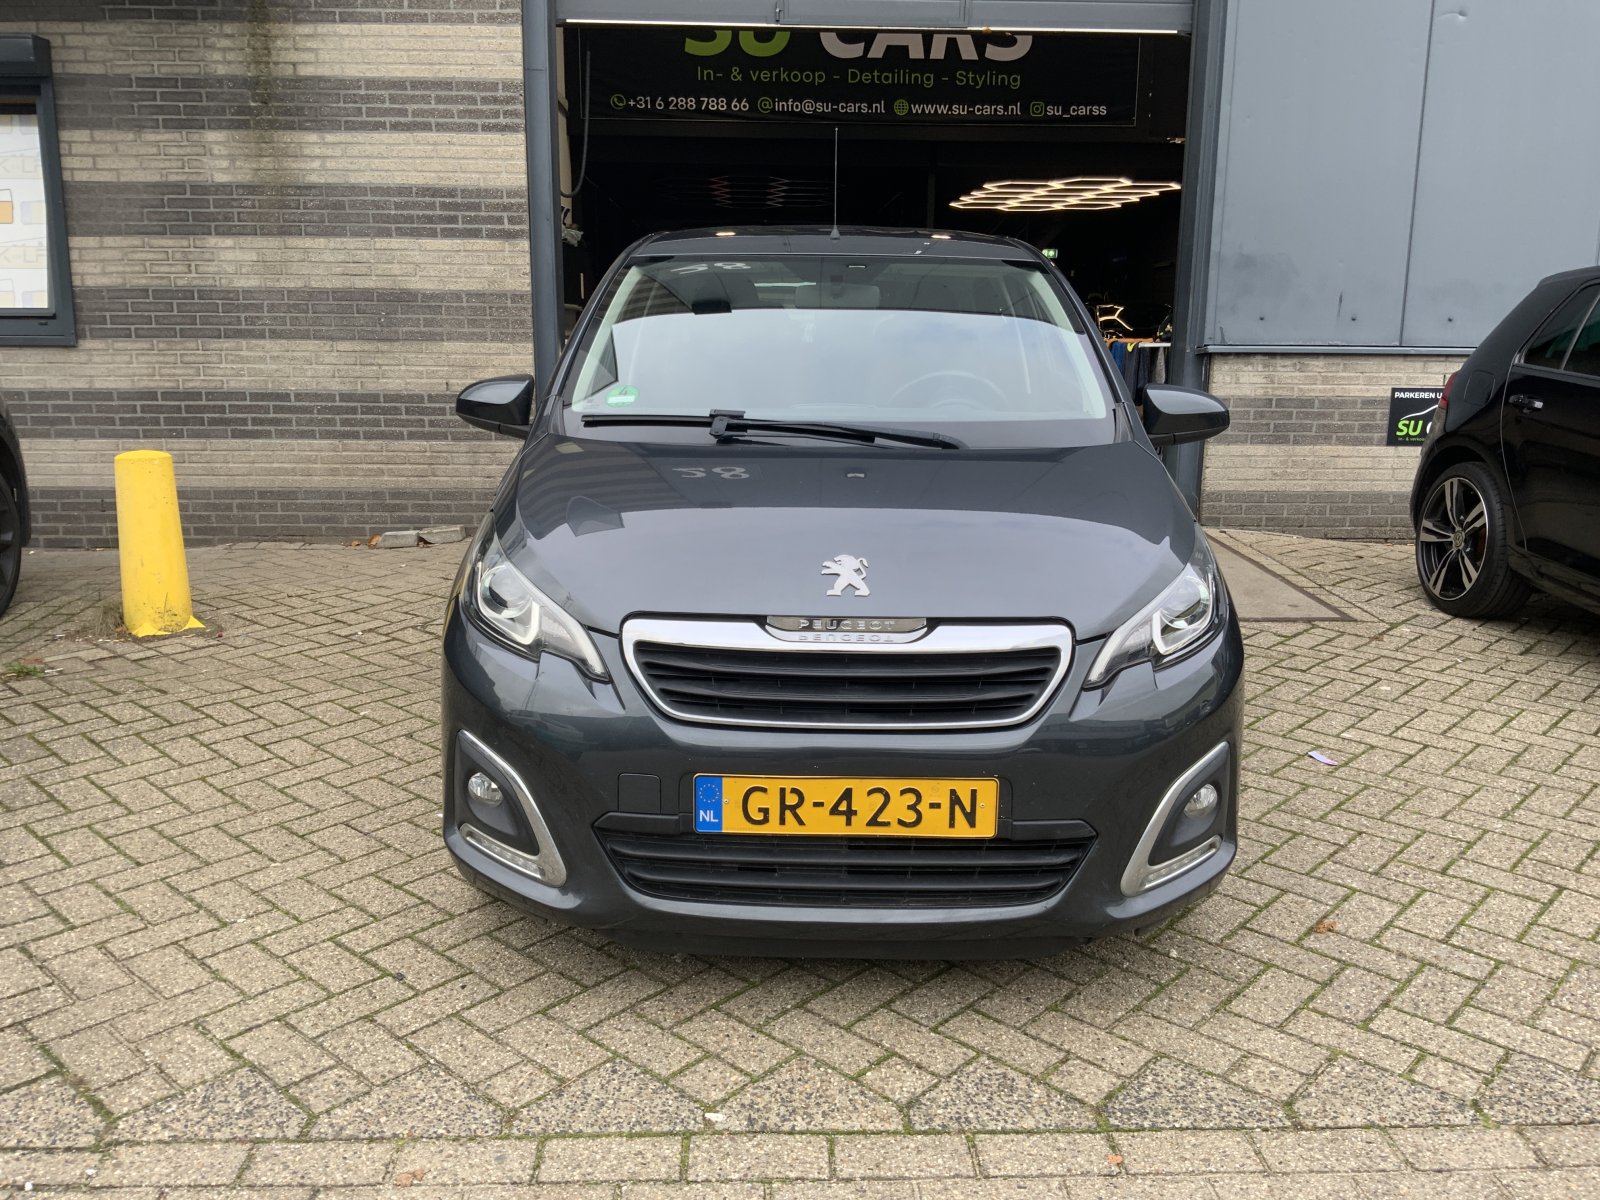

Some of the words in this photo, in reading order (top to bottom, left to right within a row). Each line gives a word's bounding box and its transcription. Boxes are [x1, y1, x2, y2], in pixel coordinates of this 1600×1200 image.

[697, 66, 724, 81] In-
[730, 66, 743, 81] &
[750, 68, 826, 86] verkoop
[848, 69, 934, 88] Detailing
[955, 71, 1021, 90] Styling
[627, 96, 651, 110] +31
[655, 96, 664, 110] 6
[668, 97, 697, 111] 288
[700, 97, 727, 111] 788
[731, 97, 749, 112] 66
[775, 97, 885, 114] info@su-cars.nl
[911, 101, 1021, 116] www.su-cars.nl
[1046, 103, 1107, 118] su_carss
[1394, 391, 1435, 399] PARKEREN
[1396, 420, 1424, 436] SU
[799, 618, 896, 631] PEUGEOT
[741, 785, 978, 829] GR-423-N
[699, 809, 719, 823] NL
